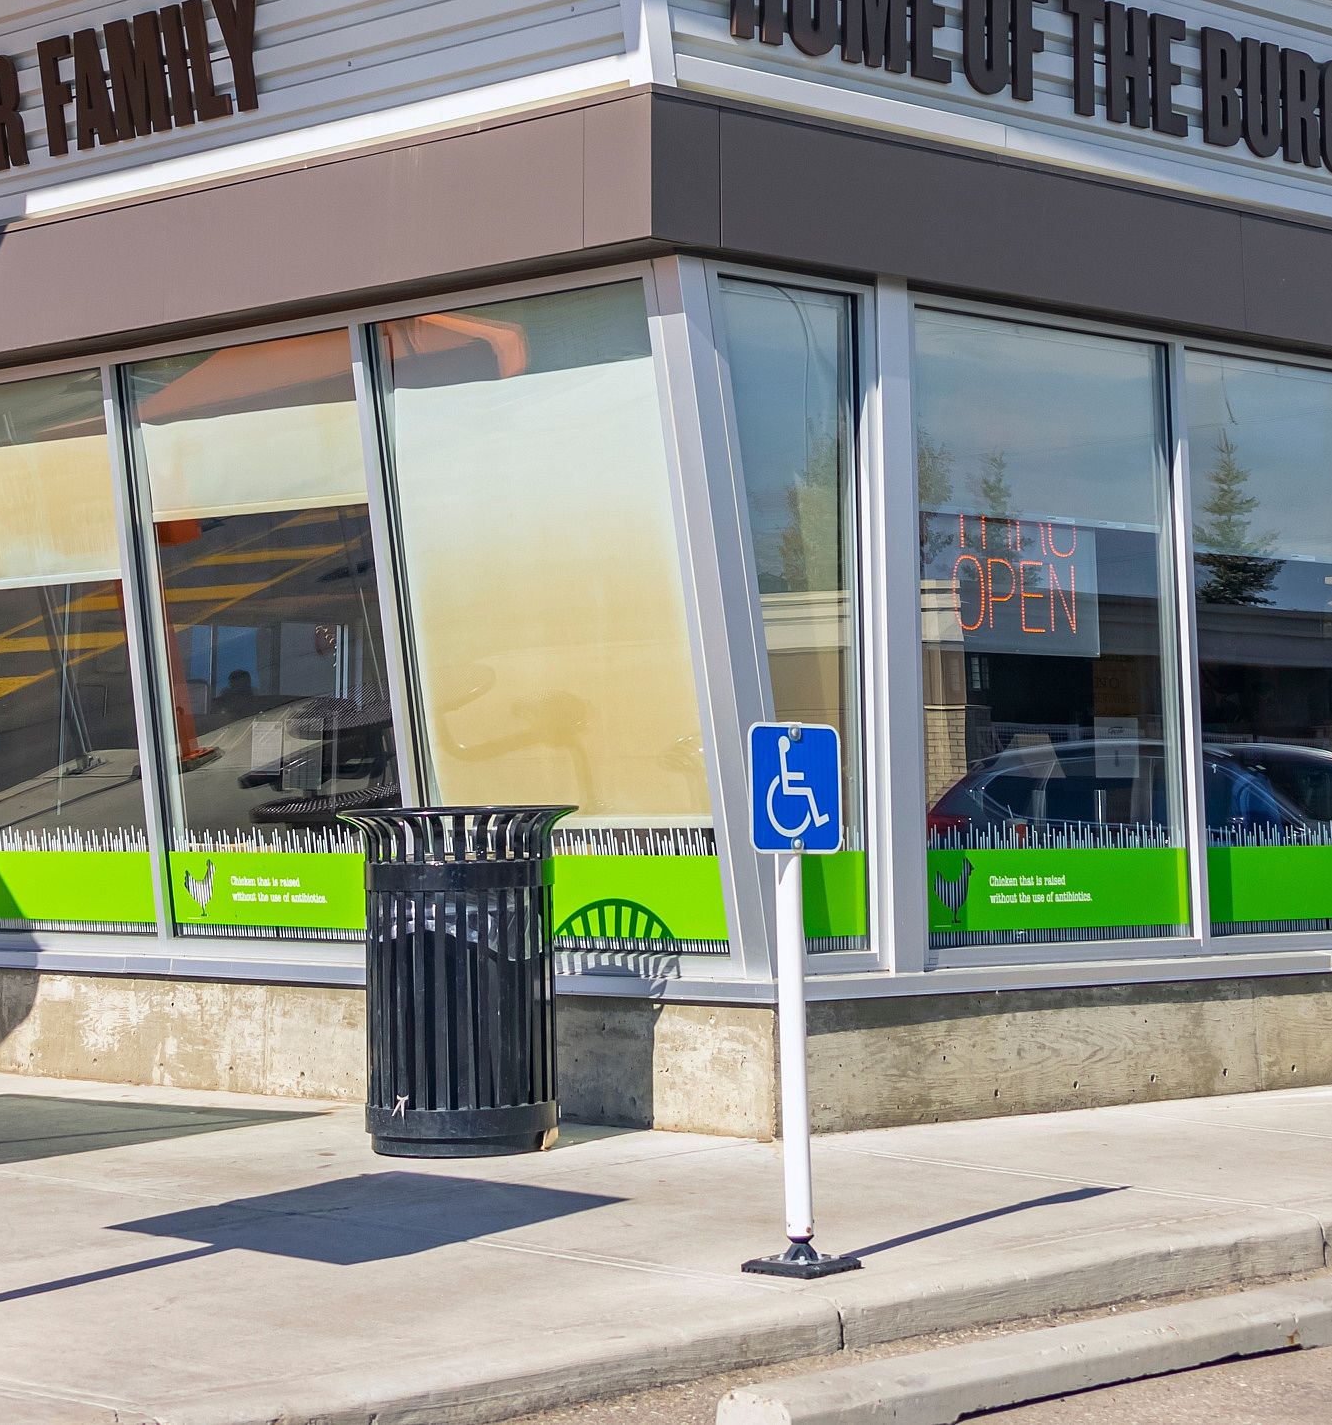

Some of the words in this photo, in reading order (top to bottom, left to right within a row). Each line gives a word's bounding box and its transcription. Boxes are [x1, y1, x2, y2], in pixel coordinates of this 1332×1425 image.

[952, 554, 1077, 634] OPEN
[230, 875, 257, 887] Chicken
[257, 875, 271, 887] that
[272, 876, 279, 887] is
[280, 876, 301, 888] raised
[989, 875, 1018, 887] Chicken
[1019, 874, 1034, 886] that
[1036, 874, 1042, 886] is
[1044, 874, 1066, 886] raised
[232, 891, 257, 902] without
[257, 891, 268, 902] the
[270, 893, 282, 903] use
[283, 891, 290, 903] of
[291, 892, 328, 904] antibiotics.
[989, 892, 1017, 904] without
[1019, 891, 1031, 903] the
[1032, 893, 1045, 903] use
[1046, 890, 1054, 903] of
[1054, 890, 1092, 903] antibiotics.
